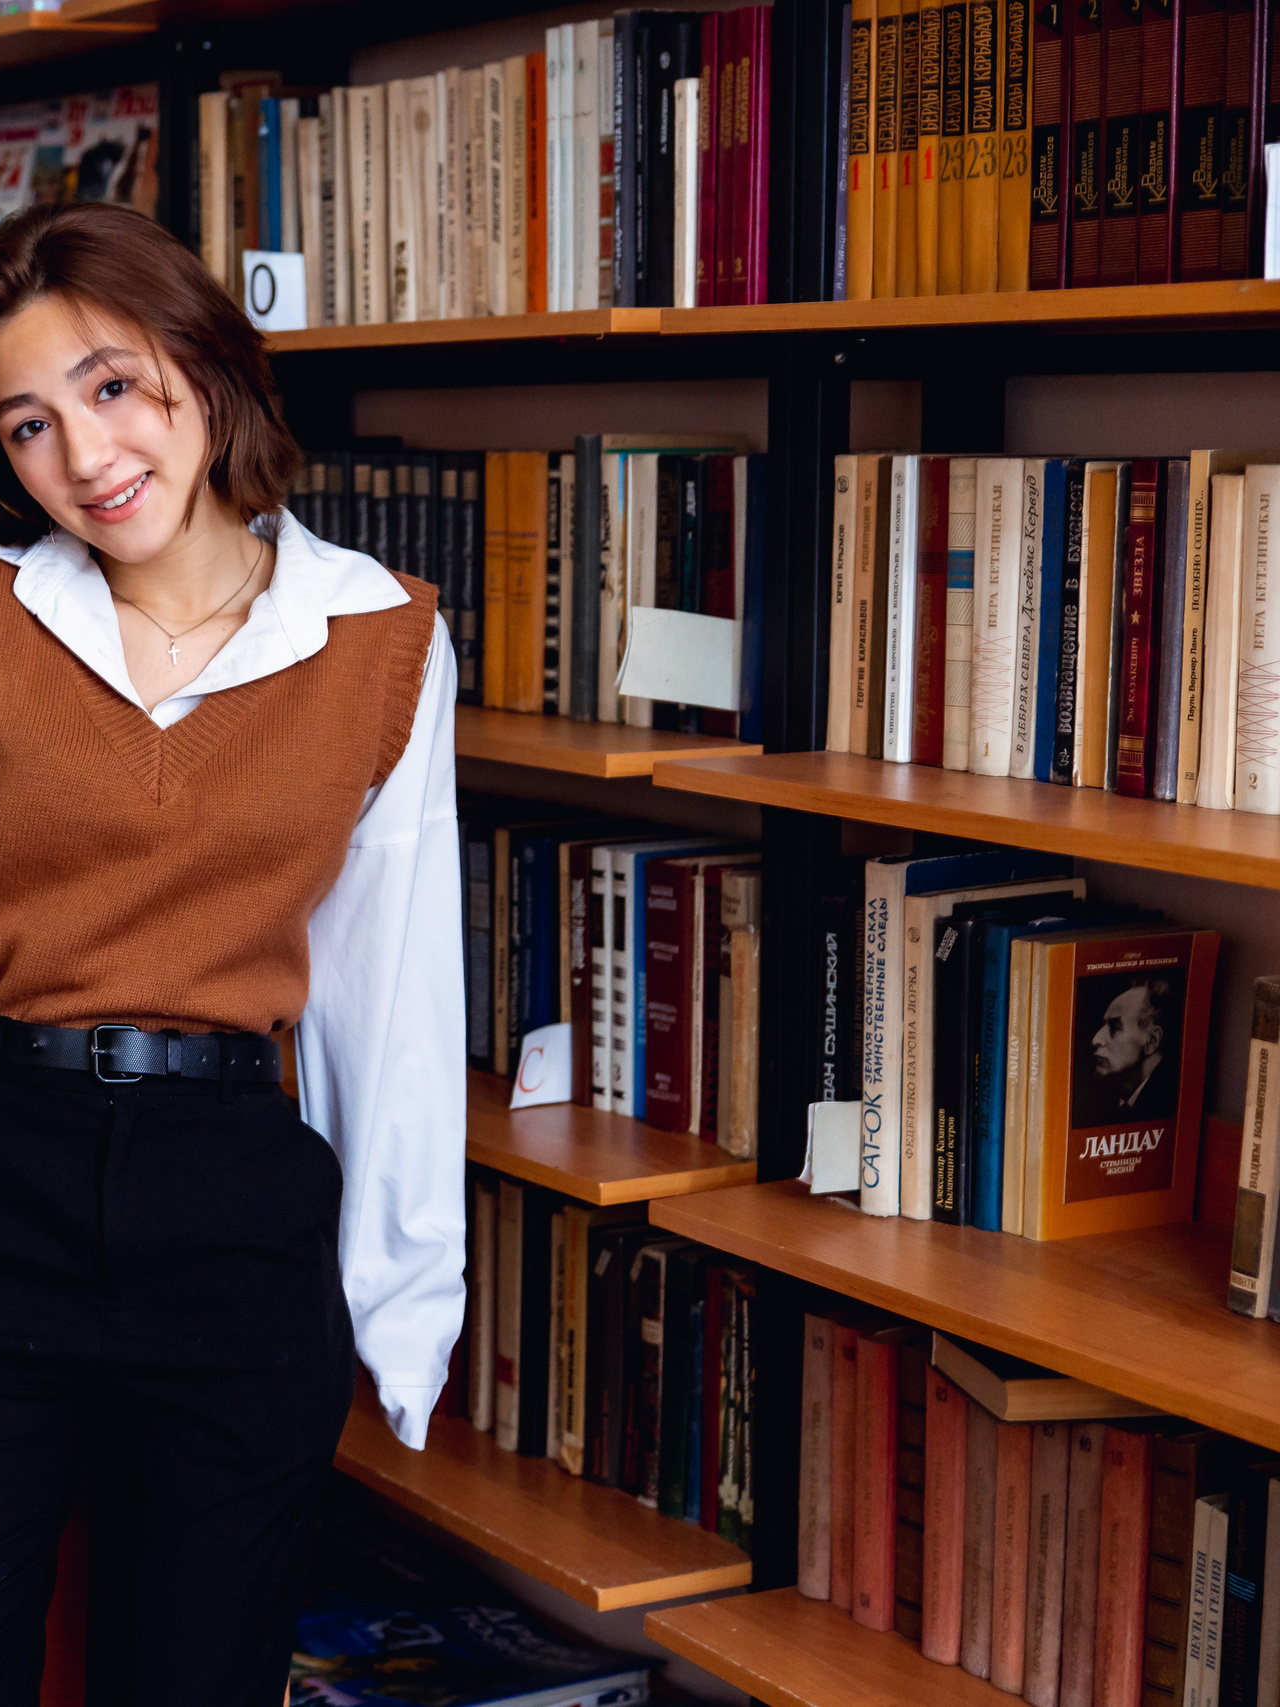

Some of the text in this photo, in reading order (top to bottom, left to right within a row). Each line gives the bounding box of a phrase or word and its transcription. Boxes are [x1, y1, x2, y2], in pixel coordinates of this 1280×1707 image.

[852, 27, 869, 153] БЕРДЫ КЕРБАБАЕВ
[879, 25, 897, 151] БЕРДЫ КЕРБАБАЕВ
[921, 9, 940, 131] БЕРДЫ КЕРБАБАЕВ
[946, 10, 962, 132] БЕРДЫ КЕРБАБАЕВ
[973, 5, 993, 129] БЕРДЫ КЕРБАБАЕВ
[1008, 1, 1024, 126] БЕРДЫ КЕРБАБАЕВ
[902, 99, 919, 148] БЕРДЫ
[923, 146, 933, 179] 1
[1142, 140, 1156, 186] Вадим
[1149, 120, 1166, 202] Кожевников
[1192, 137, 1206, 183] Вадим
[1198, 116, 1218, 199] Кожевников
[852, 158, 861, 190] 1
[881, 157, 889, 189] 1
[904, 153, 911, 185] 1
[1034, 155, 1047, 199] Вадим
[1040, 135, 1058, 214] Кожевников
[1075, 151, 1087, 196] Вадим
[1081, 131, 1098, 210] Кожевников
[1108, 147, 1121, 192] Вадим
[1114, 127, 1133, 207] Кожевников
[836, 524, 845, 603] ЮРИЙ КРЫМОВ
[988, 484, 1003, 628] ВЕРА КЕТЛИНСКАЯ
[1021, 475, 1039, 621] Джеймс Кервуд
[1133, 536, 1145, 597] ЗВЕЗДА
[1192, 490, 1205, 611] ПОДОБНО СОЛНЦУ...
[1254, 493, 1270, 651] ВЕРА КЕТЛИНСКАЯ
[857, 600, 868, 708] ГЕОРГИЙ КАРАСЛАВОВ
[1016, 625, 1031, 753] В ДЕБРЯХ СЕВЕРА
[1127, 637, 1139, 722] Эм. КАЗАКЕВИЧ
[1187, 628, 1198, 721] Пауль Вернер Ланге
[1248, 773, 1258, 789] 2
[867, 899, 877, 944] СКАЛ
[825, 932, 838, 1055] СУШИНСКИЙ
[872, 897, 888, 1084] ТАИНСТВЕННЫЕ СЛЕДЫ
[864, 1032, 874, 1084] ЗЕМЛЯ
[905, 965, 918, 1159] ФЕДЕРИКО ГАРСИА ЛОРКА
[1008, 1035, 1020, 1083] ЛАНДАУ
[862, 1091, 883, 1188] САТ-ОК
[936, 1108, 945, 1208] Александр Казанцев
[1079, 1128, 1165, 1160] ЛАНДАУ
[1100, 1156, 1142, 1169] СТРАНИЦЫ
[1106, 1164, 1135, 1176] ЖИЗНИ
[945, 1151, 955, 1210] Пылающий
[1190, 1551, 1207, 1660] ВЕСНА ГЕНИЯ
[1206, 1560, 1222, 1670] ВЕСНА ГЕНИЯ
